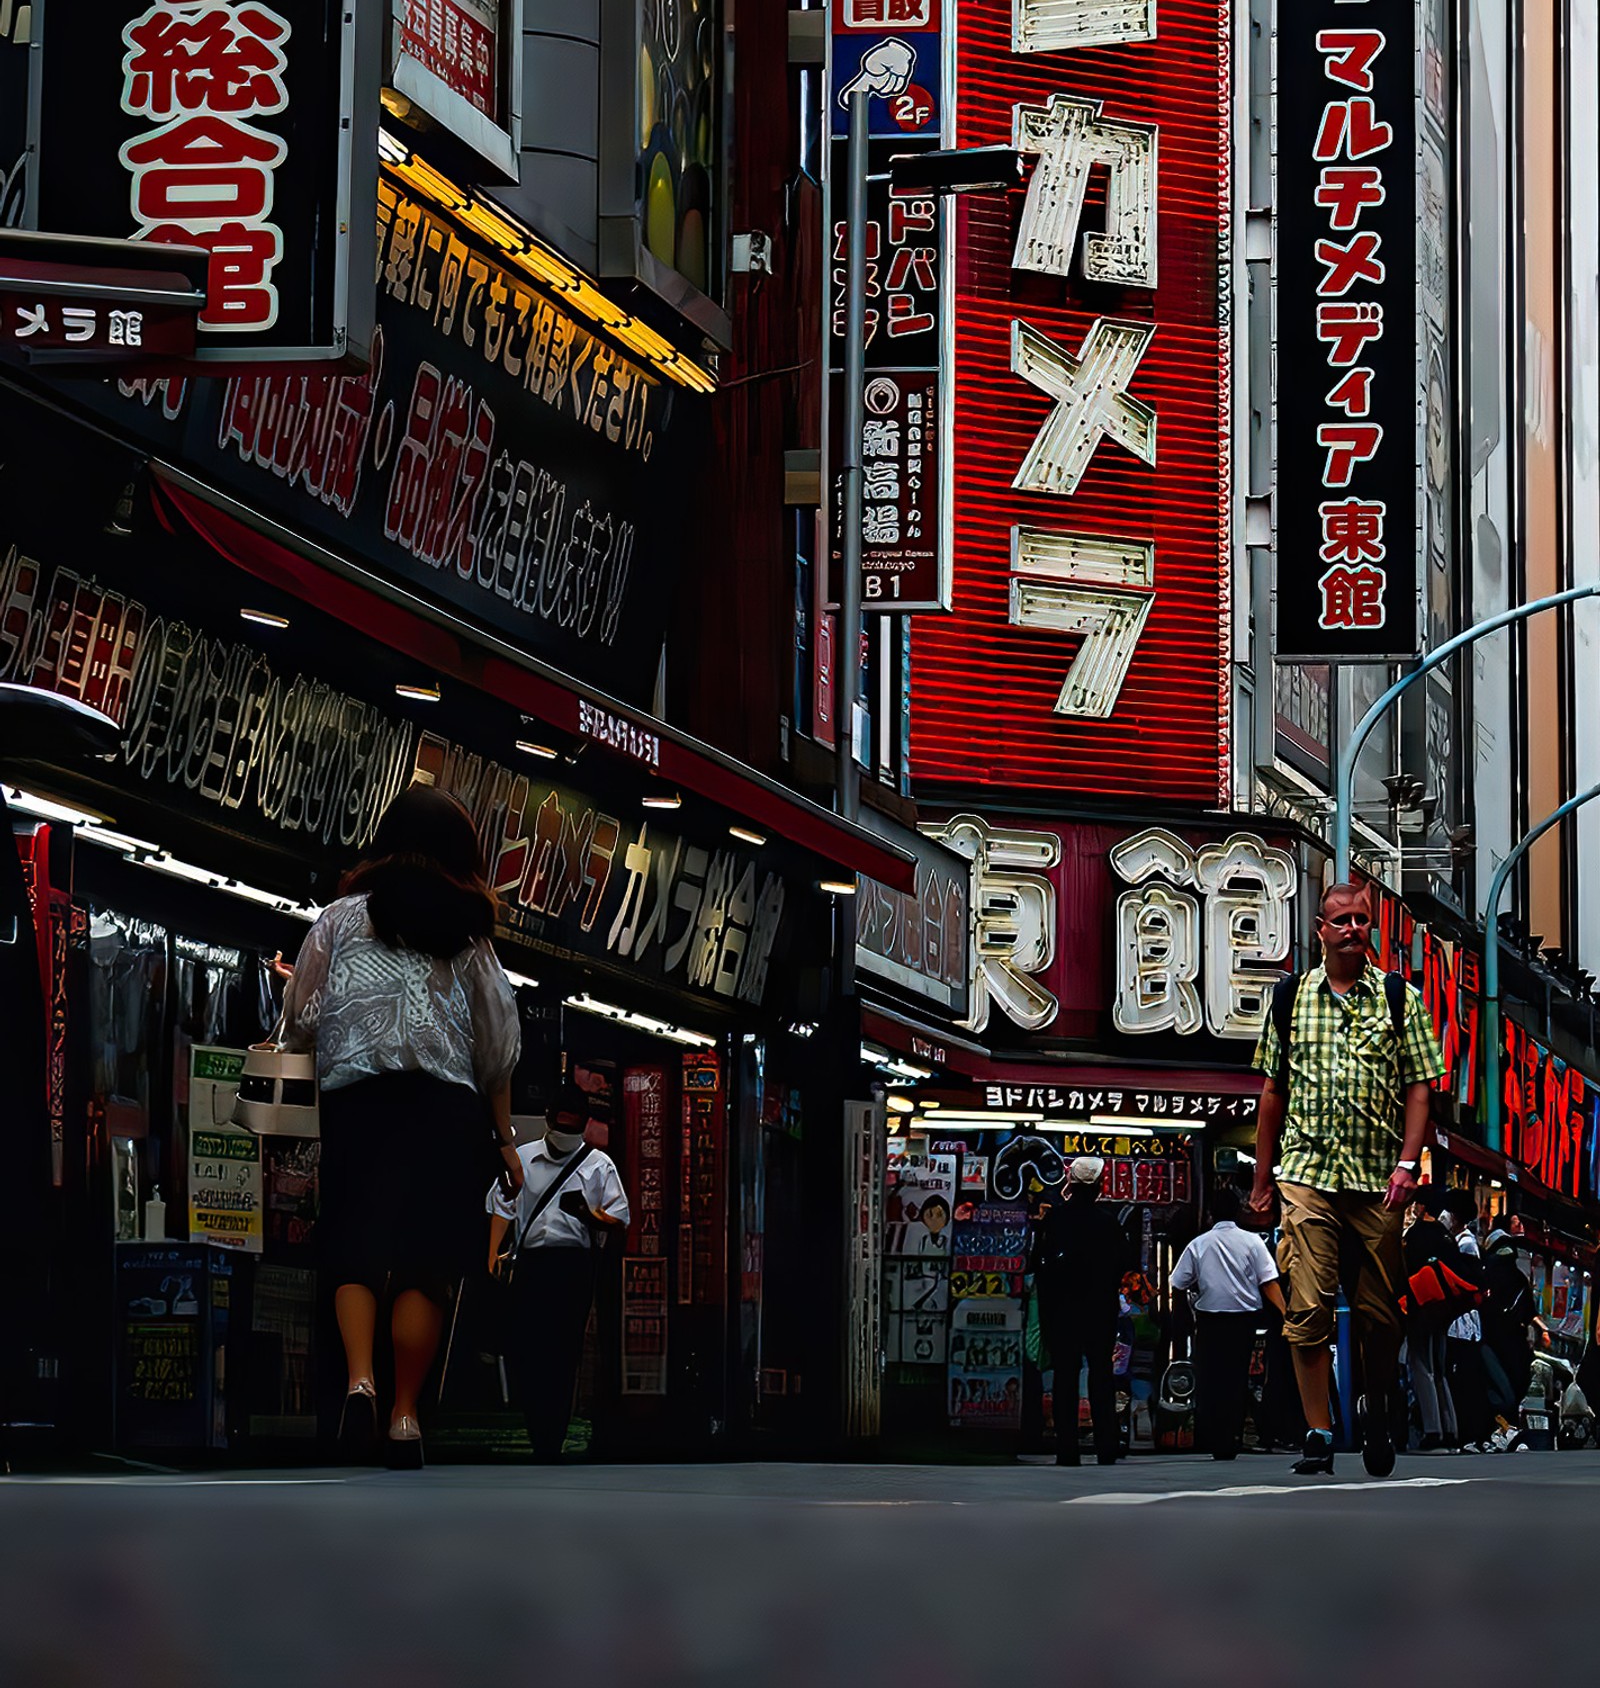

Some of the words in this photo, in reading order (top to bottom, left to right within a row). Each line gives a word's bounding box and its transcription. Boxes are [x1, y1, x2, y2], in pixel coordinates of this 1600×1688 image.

[895, 95, 929, 126] 2F
[866, 574, 901, 599] B1
[917, 813, 1298, 1041] 東館
[985, 1086, 1124, 1112] ヨドバシカメラ
